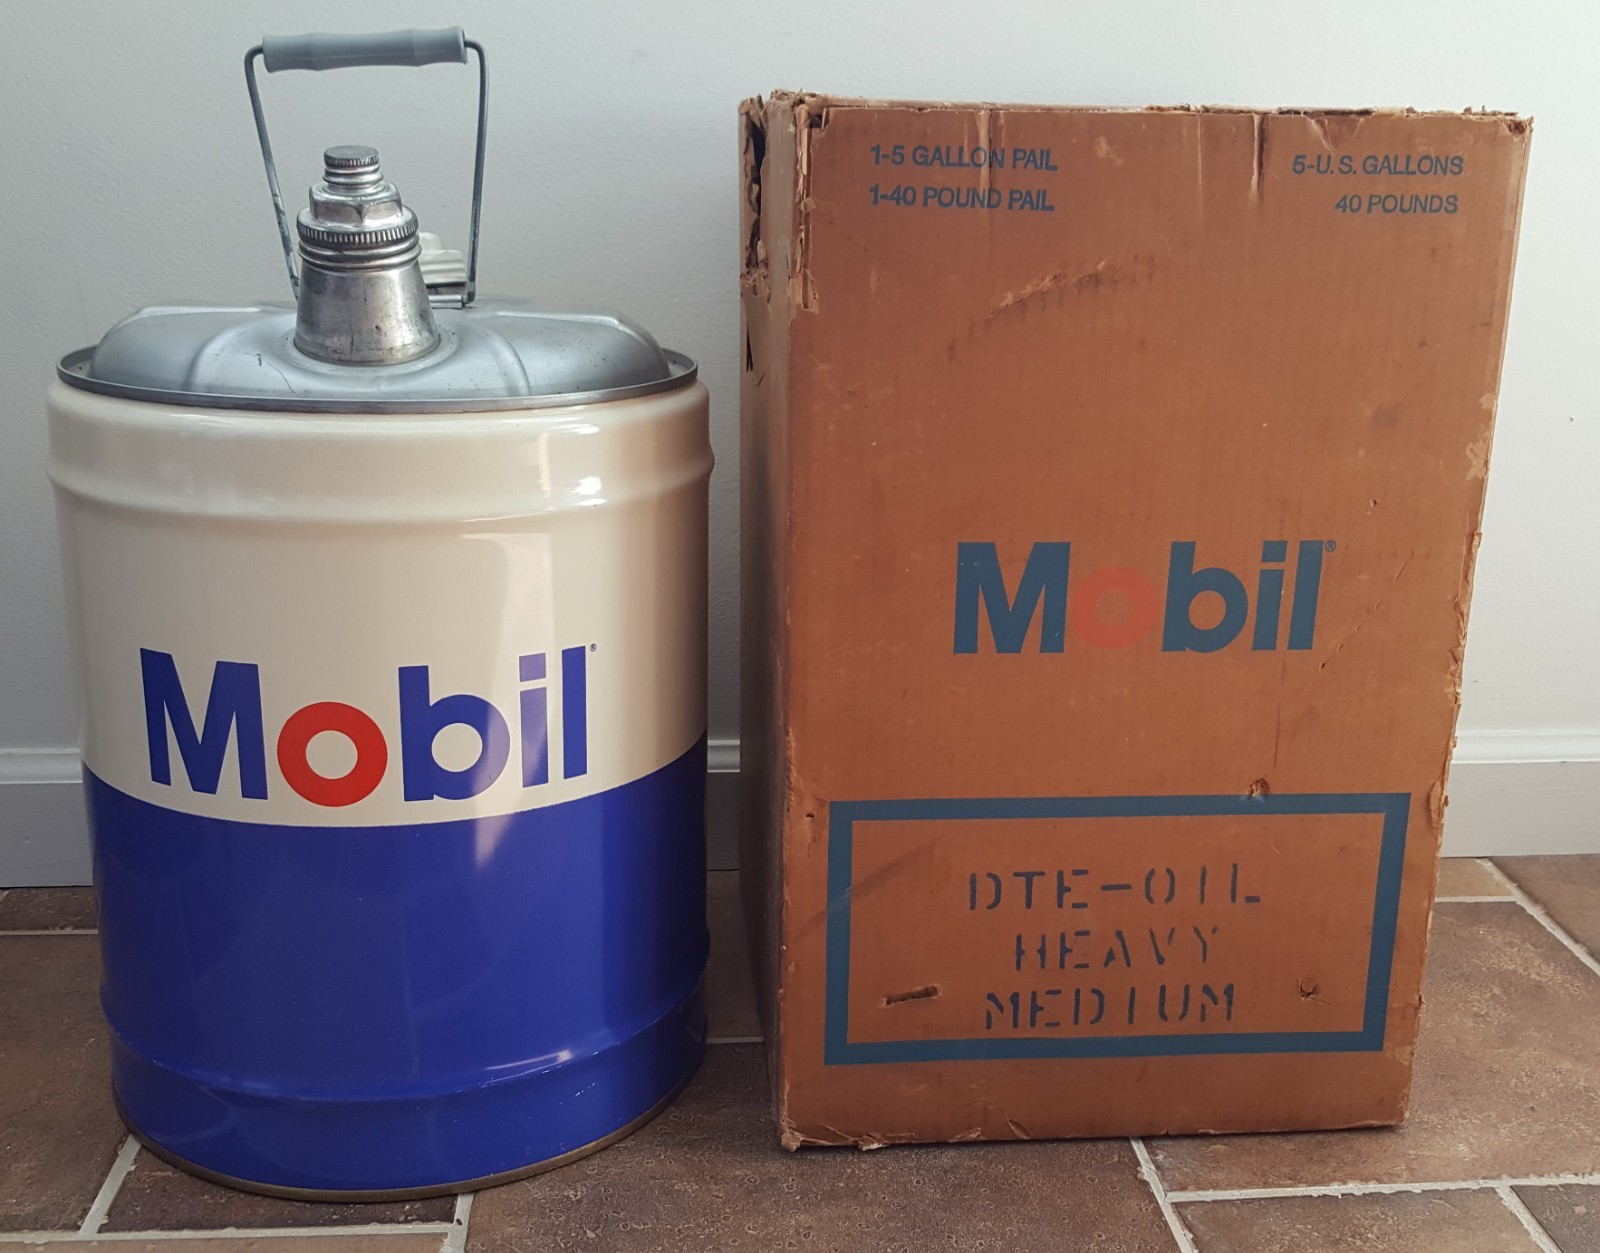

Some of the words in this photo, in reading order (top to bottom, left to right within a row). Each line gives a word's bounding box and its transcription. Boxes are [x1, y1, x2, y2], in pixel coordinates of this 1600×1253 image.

[870, 144, 905, 166] 1-5
[911, 145, 1005, 169] GALLON
[1011, 148, 1058, 171] PAIL
[1362, 154, 1464, 176] GALLONS
[869, 184, 916, 206] 1-40
[922, 186, 1001, 209] POUND
[1007, 189, 1055, 212] PAIL
[1335, 194, 1362, 213] 40
[1366, 194, 1459, 214] POUNDS
[969, 862, 1261, 911] DTE-OIL
[1014, 926, 1218, 971] HEAVY
[986, 983, 1234, 1030] MEDIUM
